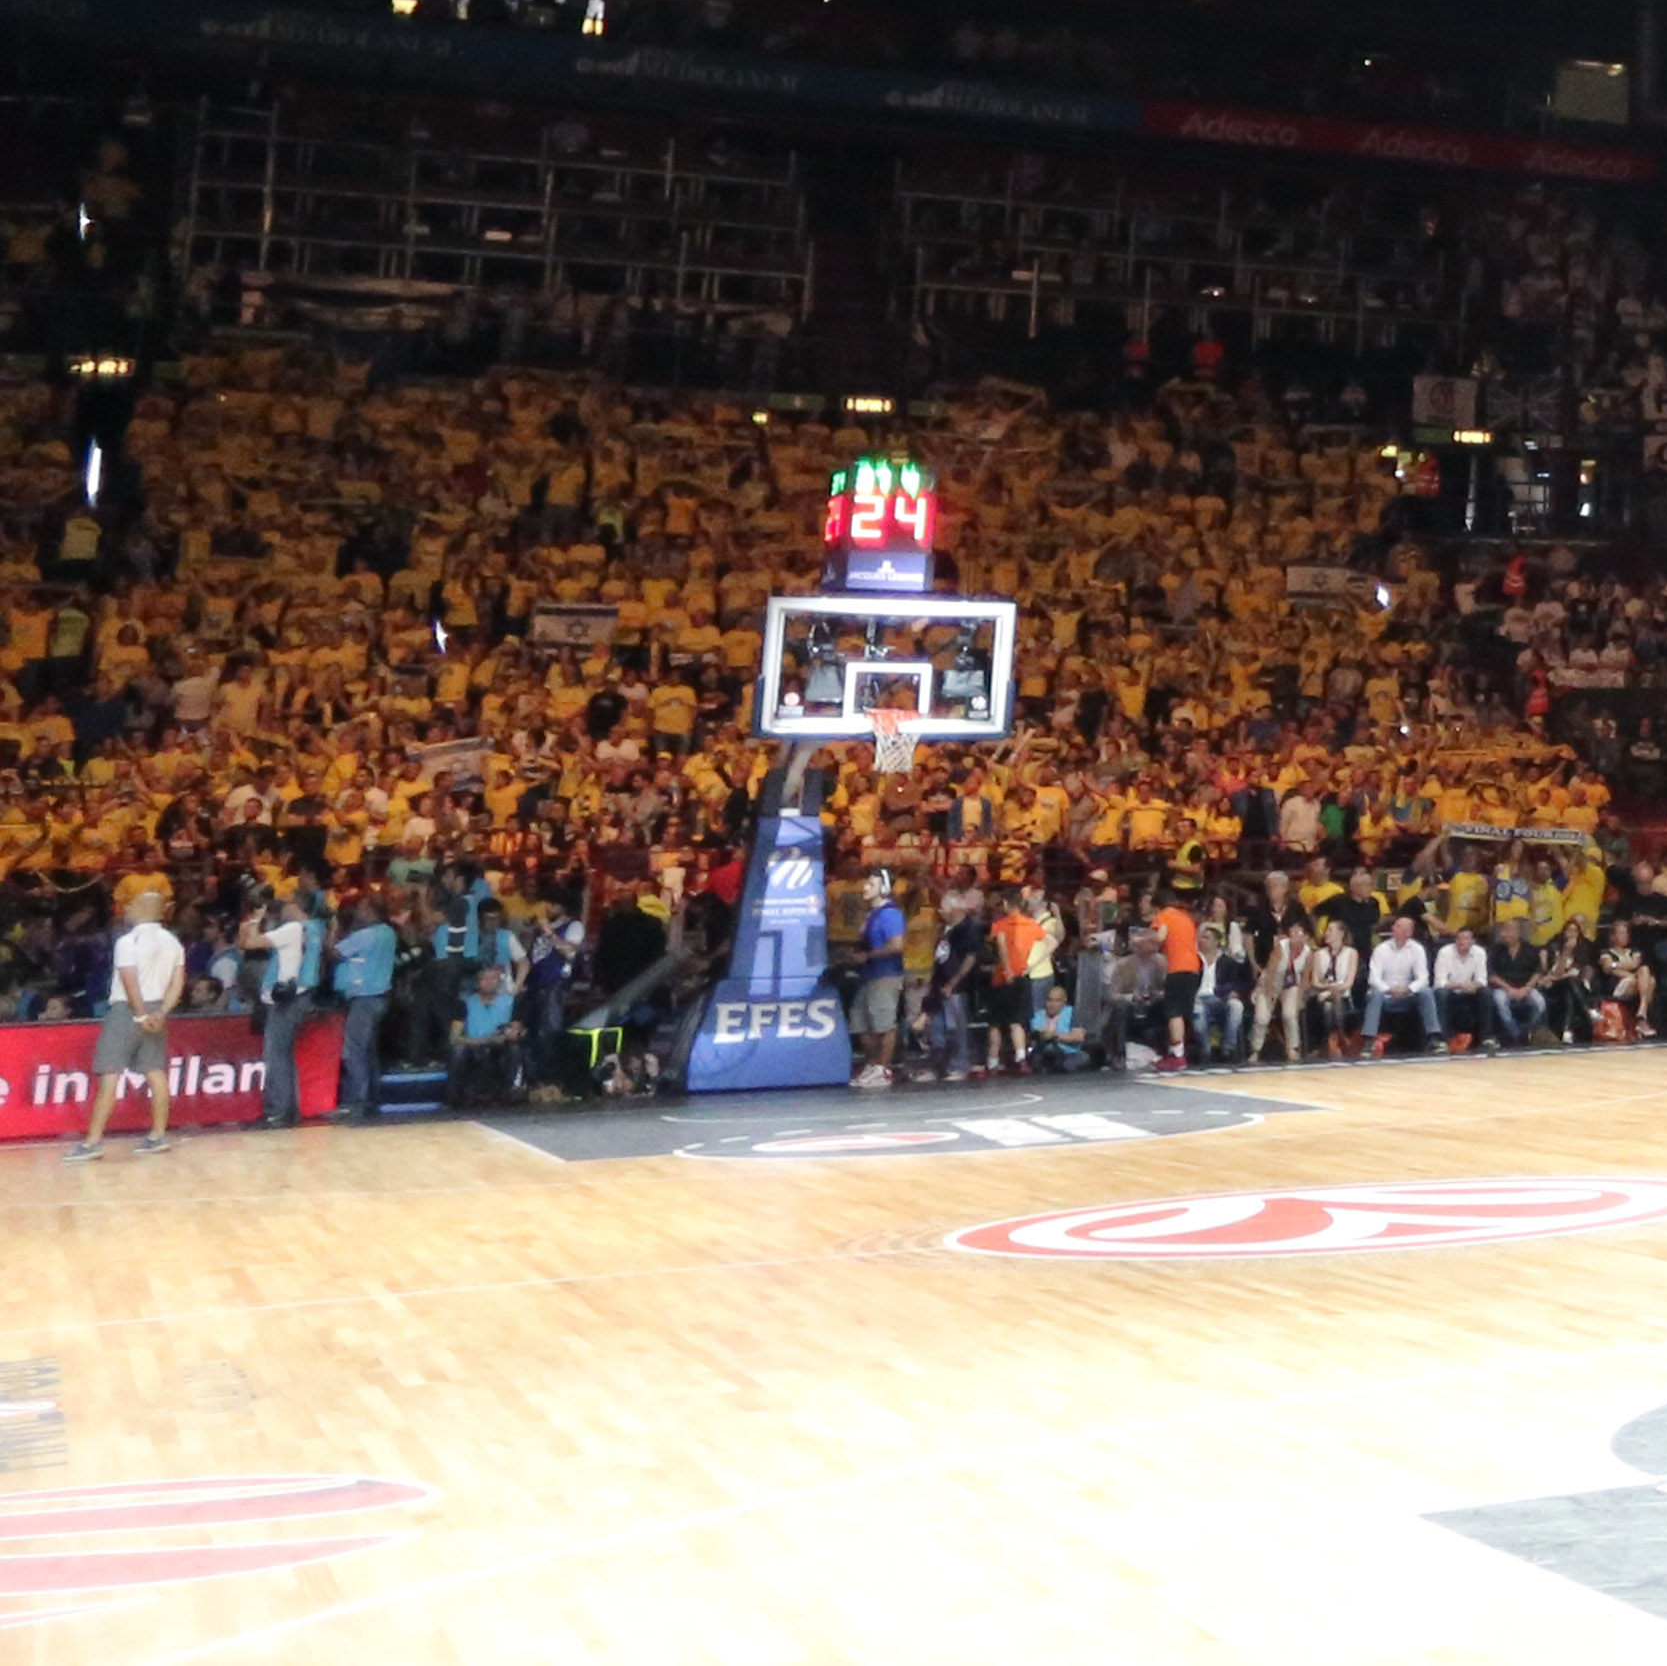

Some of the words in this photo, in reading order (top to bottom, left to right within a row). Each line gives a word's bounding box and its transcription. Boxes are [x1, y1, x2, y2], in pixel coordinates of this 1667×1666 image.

[1180, 110, 1296, 147] Adecco
[1357, 129, 1468, 164] Adecco
[851, 494, 927, 540] 24
[713, 998, 837, 1045] EFES
[34, 1064, 88, 1104] in
